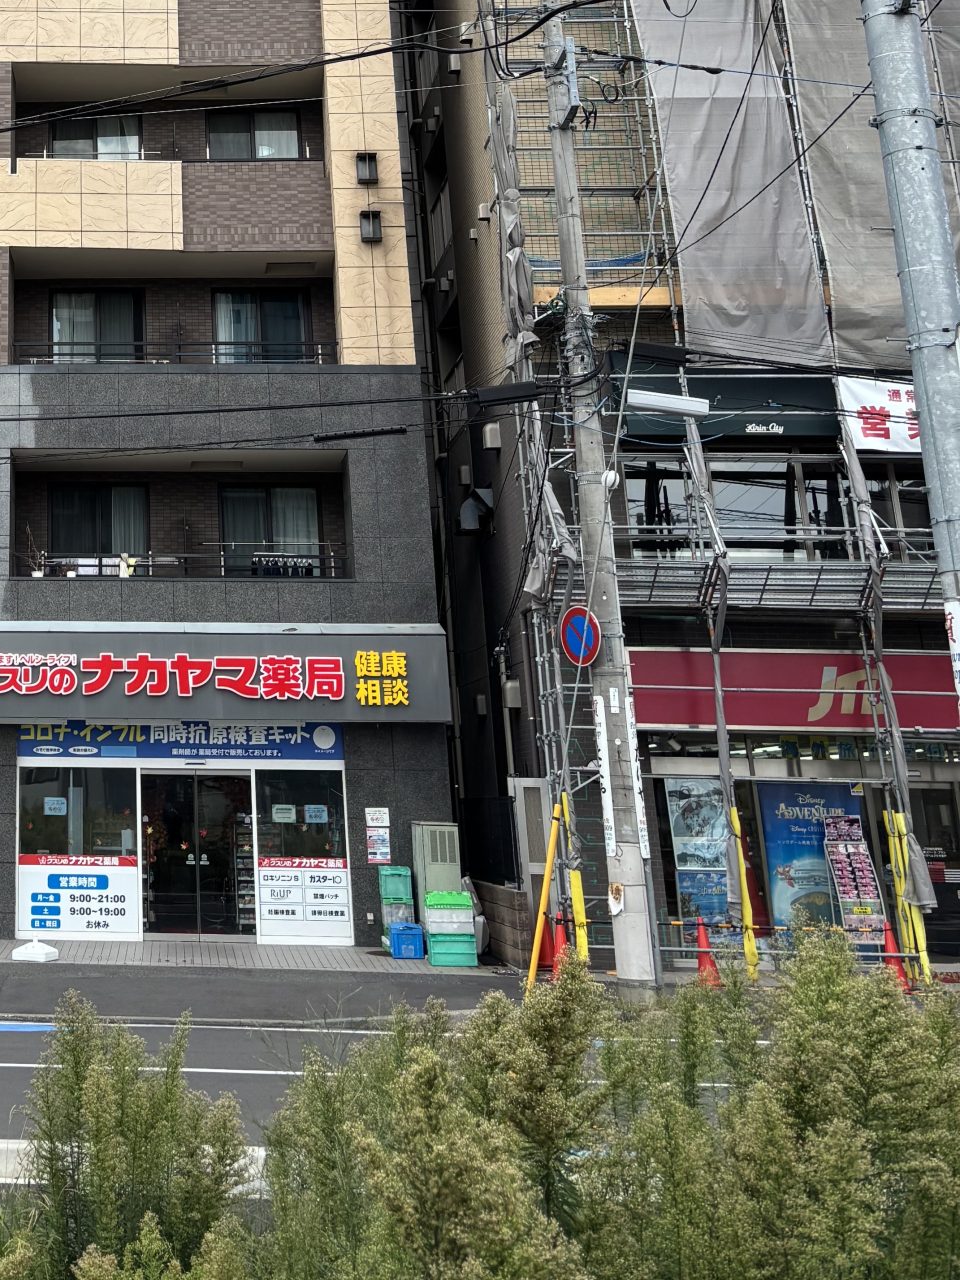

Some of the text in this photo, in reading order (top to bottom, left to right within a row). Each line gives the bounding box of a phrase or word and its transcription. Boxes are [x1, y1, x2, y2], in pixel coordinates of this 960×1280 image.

[354, 650, 408, 678] 健康
[355, 679, 410, 707] 相談
[807, 666, 893, 721] JTB
[59, 877, 97, 888] 営業時間
[85, 920, 110, 929] お休み
